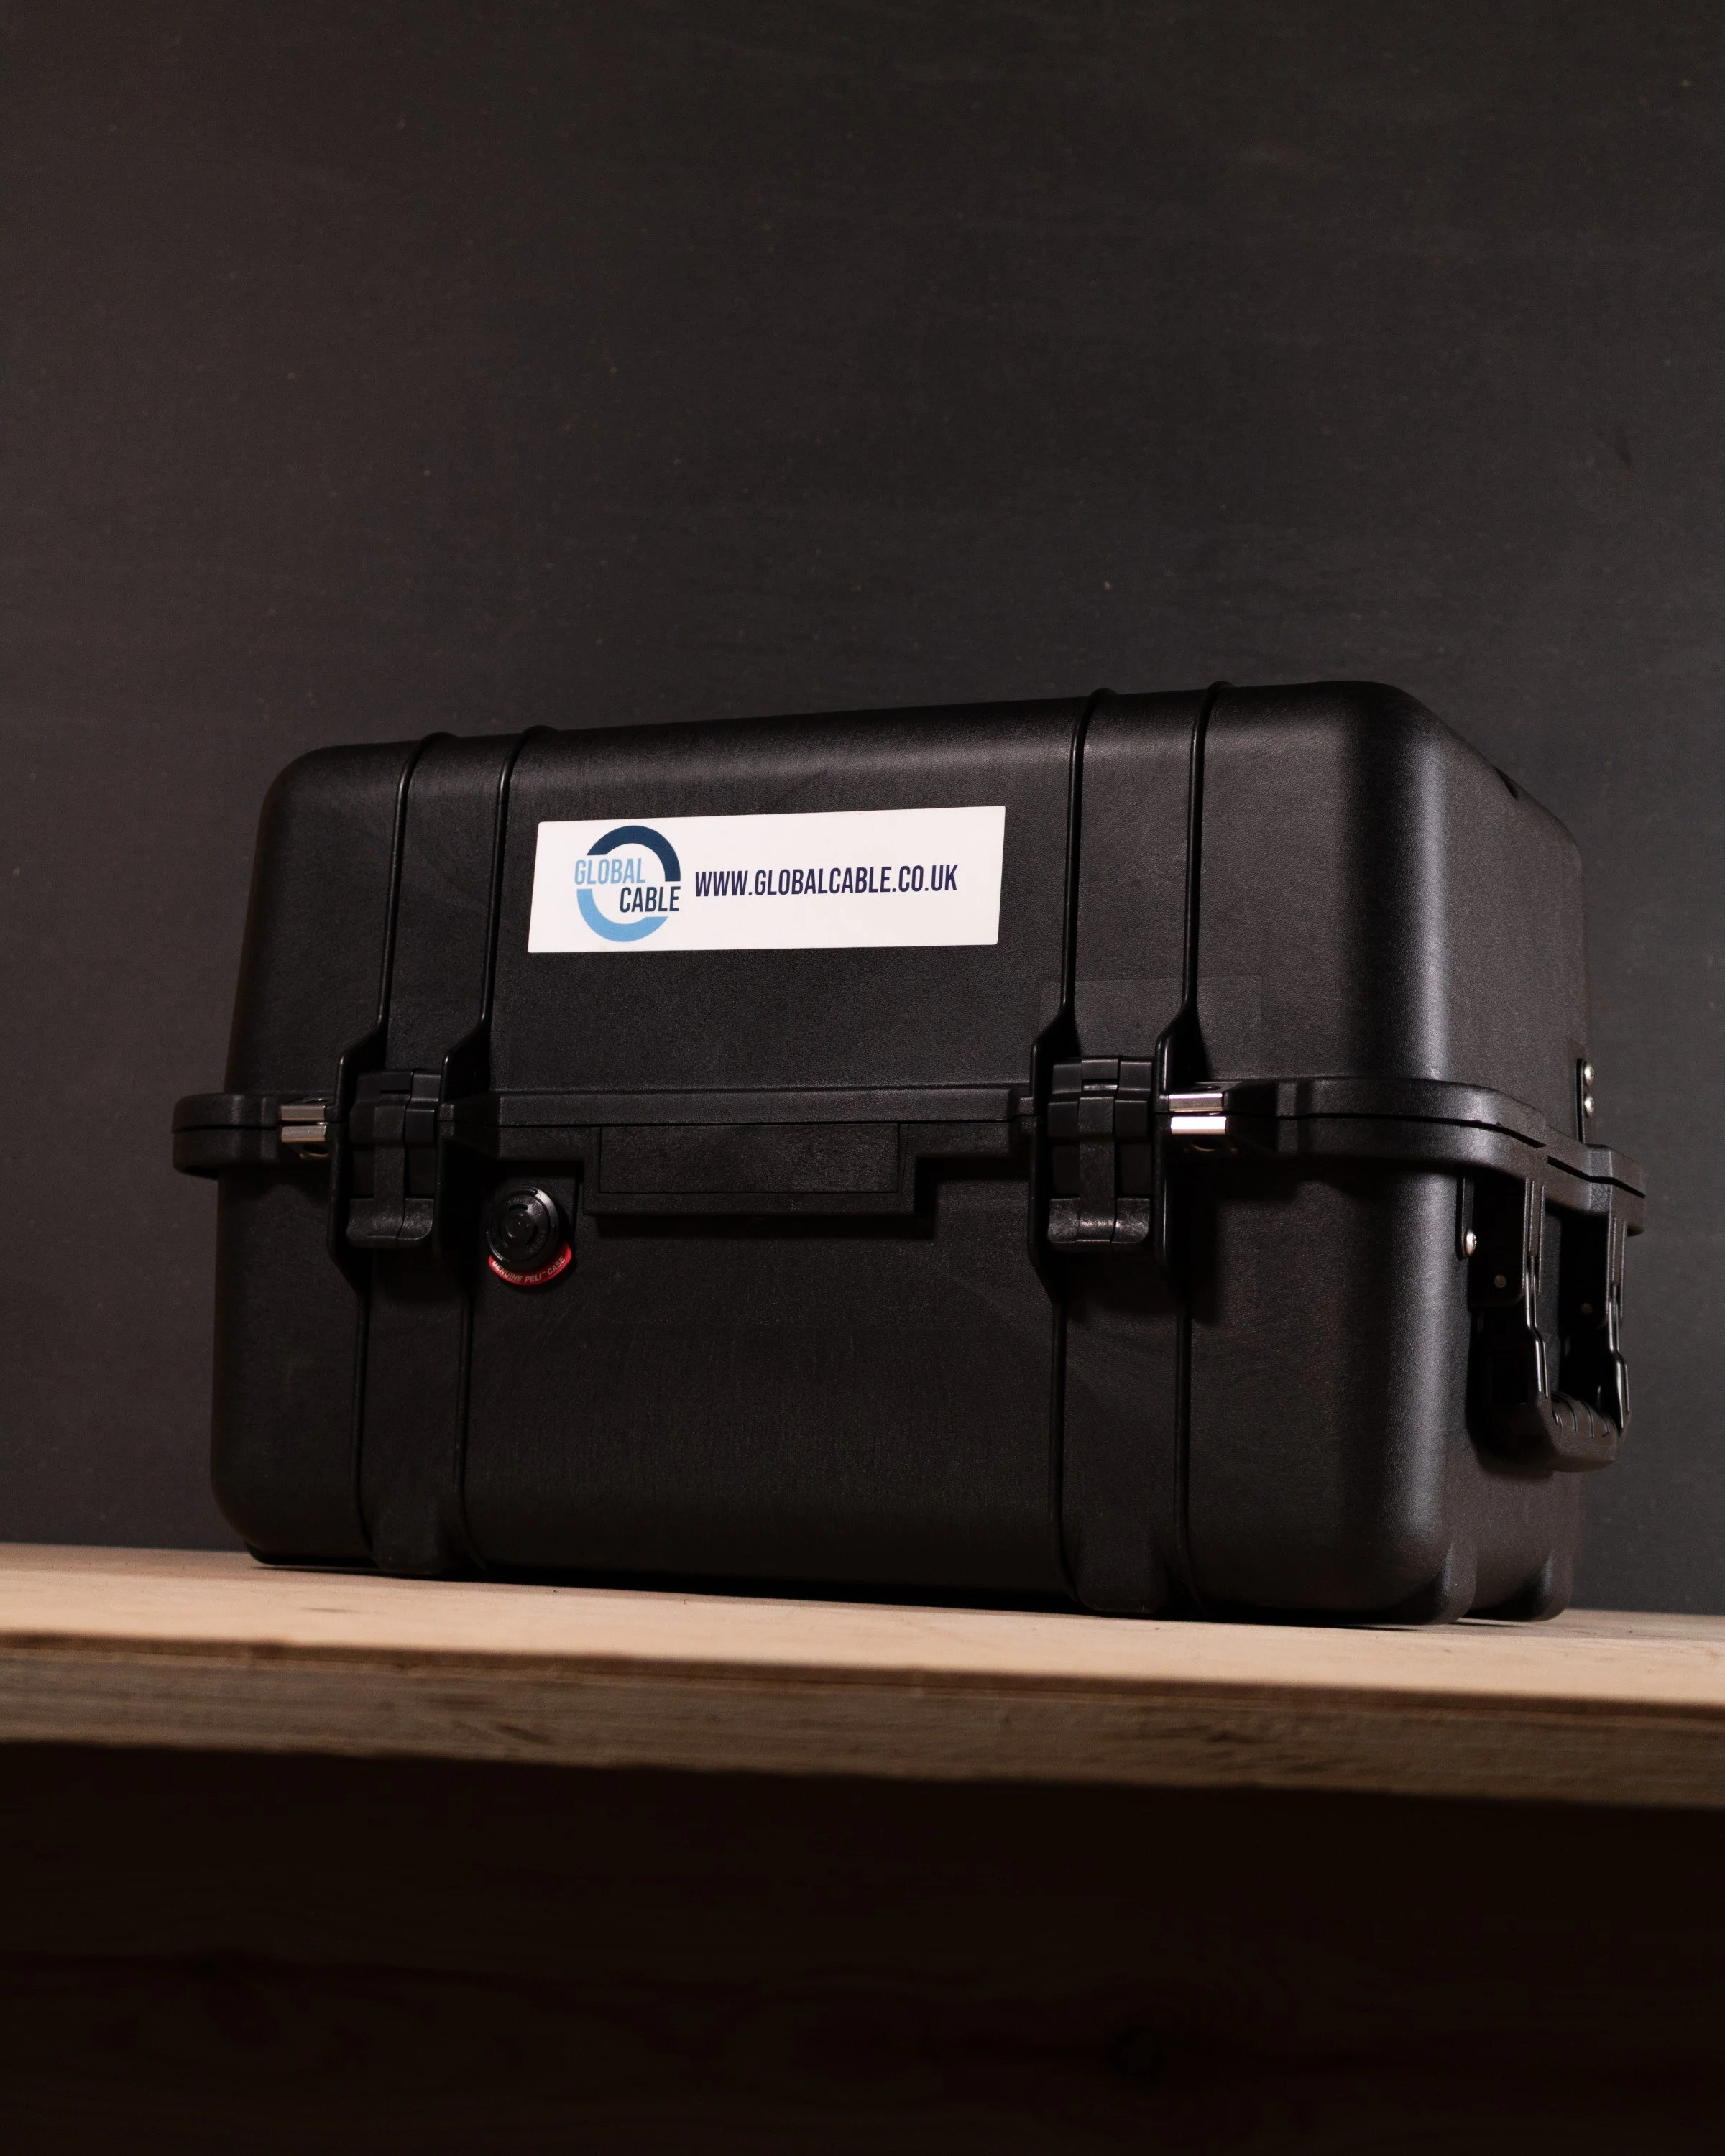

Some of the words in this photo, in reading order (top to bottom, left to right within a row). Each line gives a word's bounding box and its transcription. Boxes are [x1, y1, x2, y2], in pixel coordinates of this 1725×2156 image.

[574, 858, 646, 885] GLOBAL
[695, 865, 958, 897] WWW.GLOBALCABLE.CO.UK
[619, 886, 680, 913] CABLE
[547, 1256, 566, 1275] CASE
